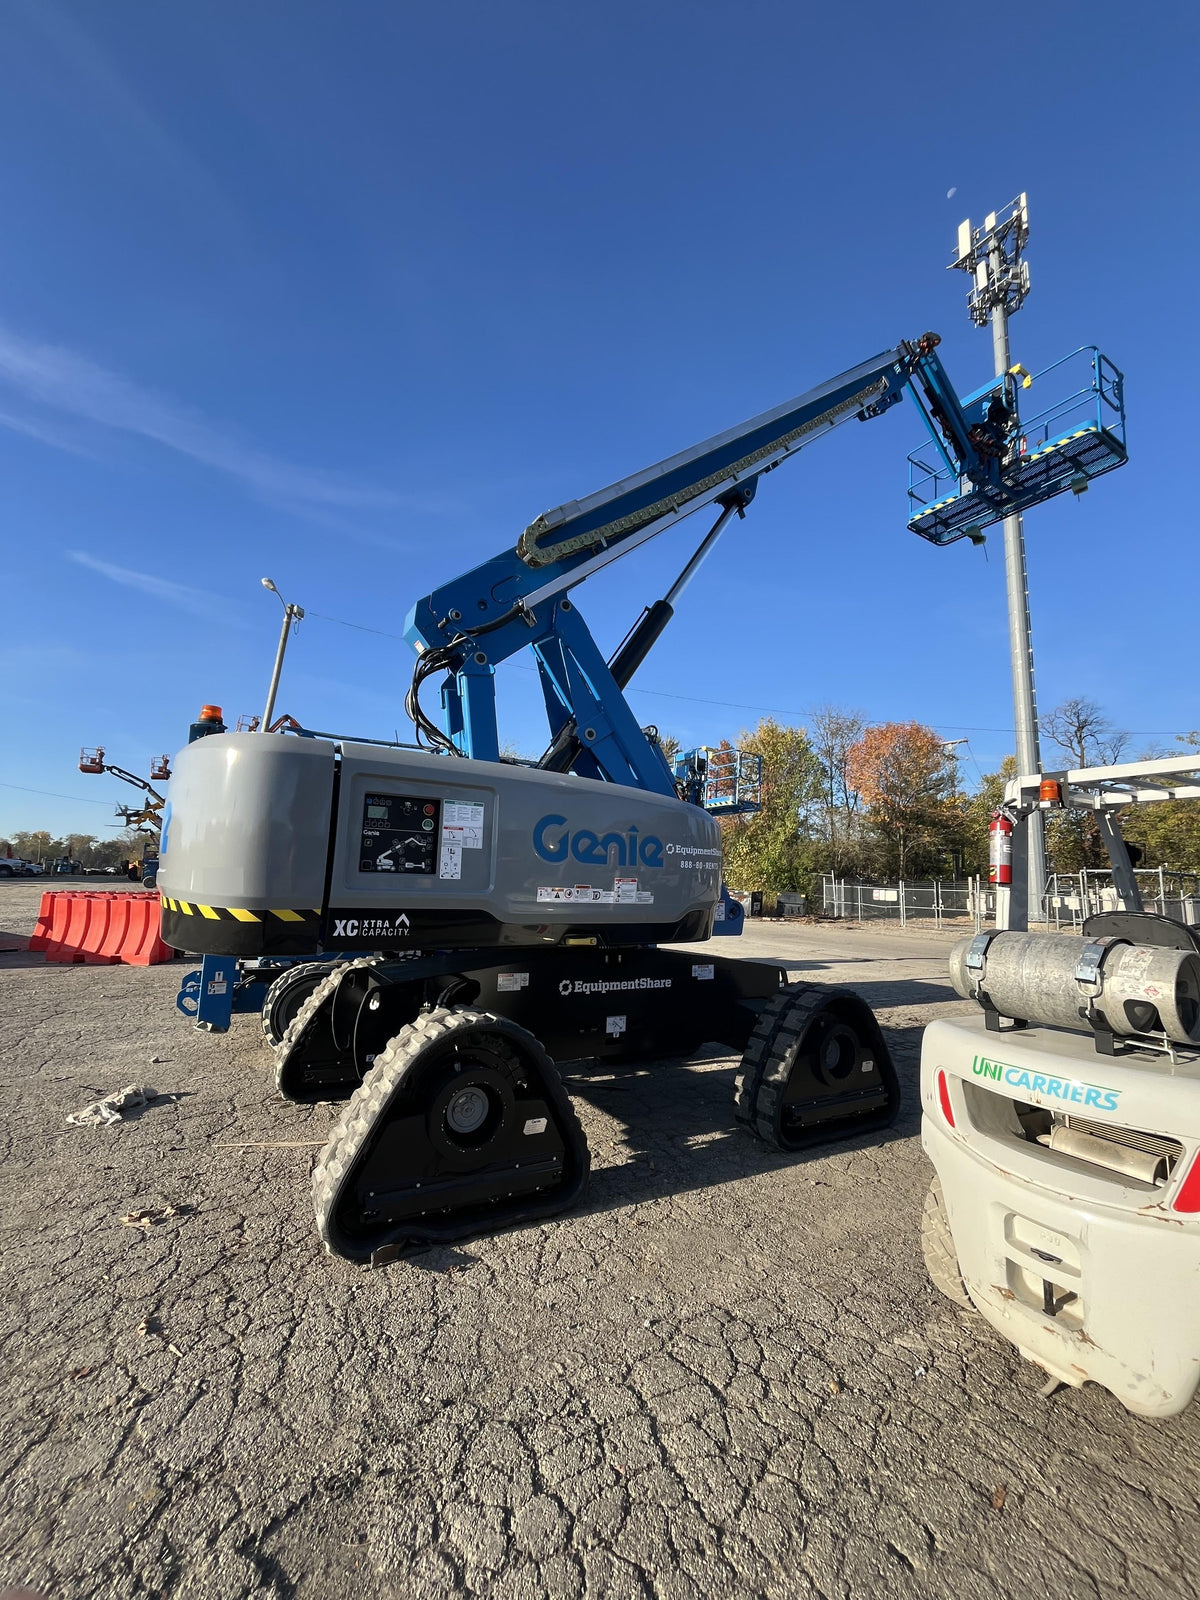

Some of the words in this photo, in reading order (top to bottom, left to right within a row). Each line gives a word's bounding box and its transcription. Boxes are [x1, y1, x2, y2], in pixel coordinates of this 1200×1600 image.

[533, 814, 664, 867] Genie
[332, 919, 359, 937] XC
[363, 920, 390, 928] XTRA
[573, 977, 673, 995] EquipmentShare
